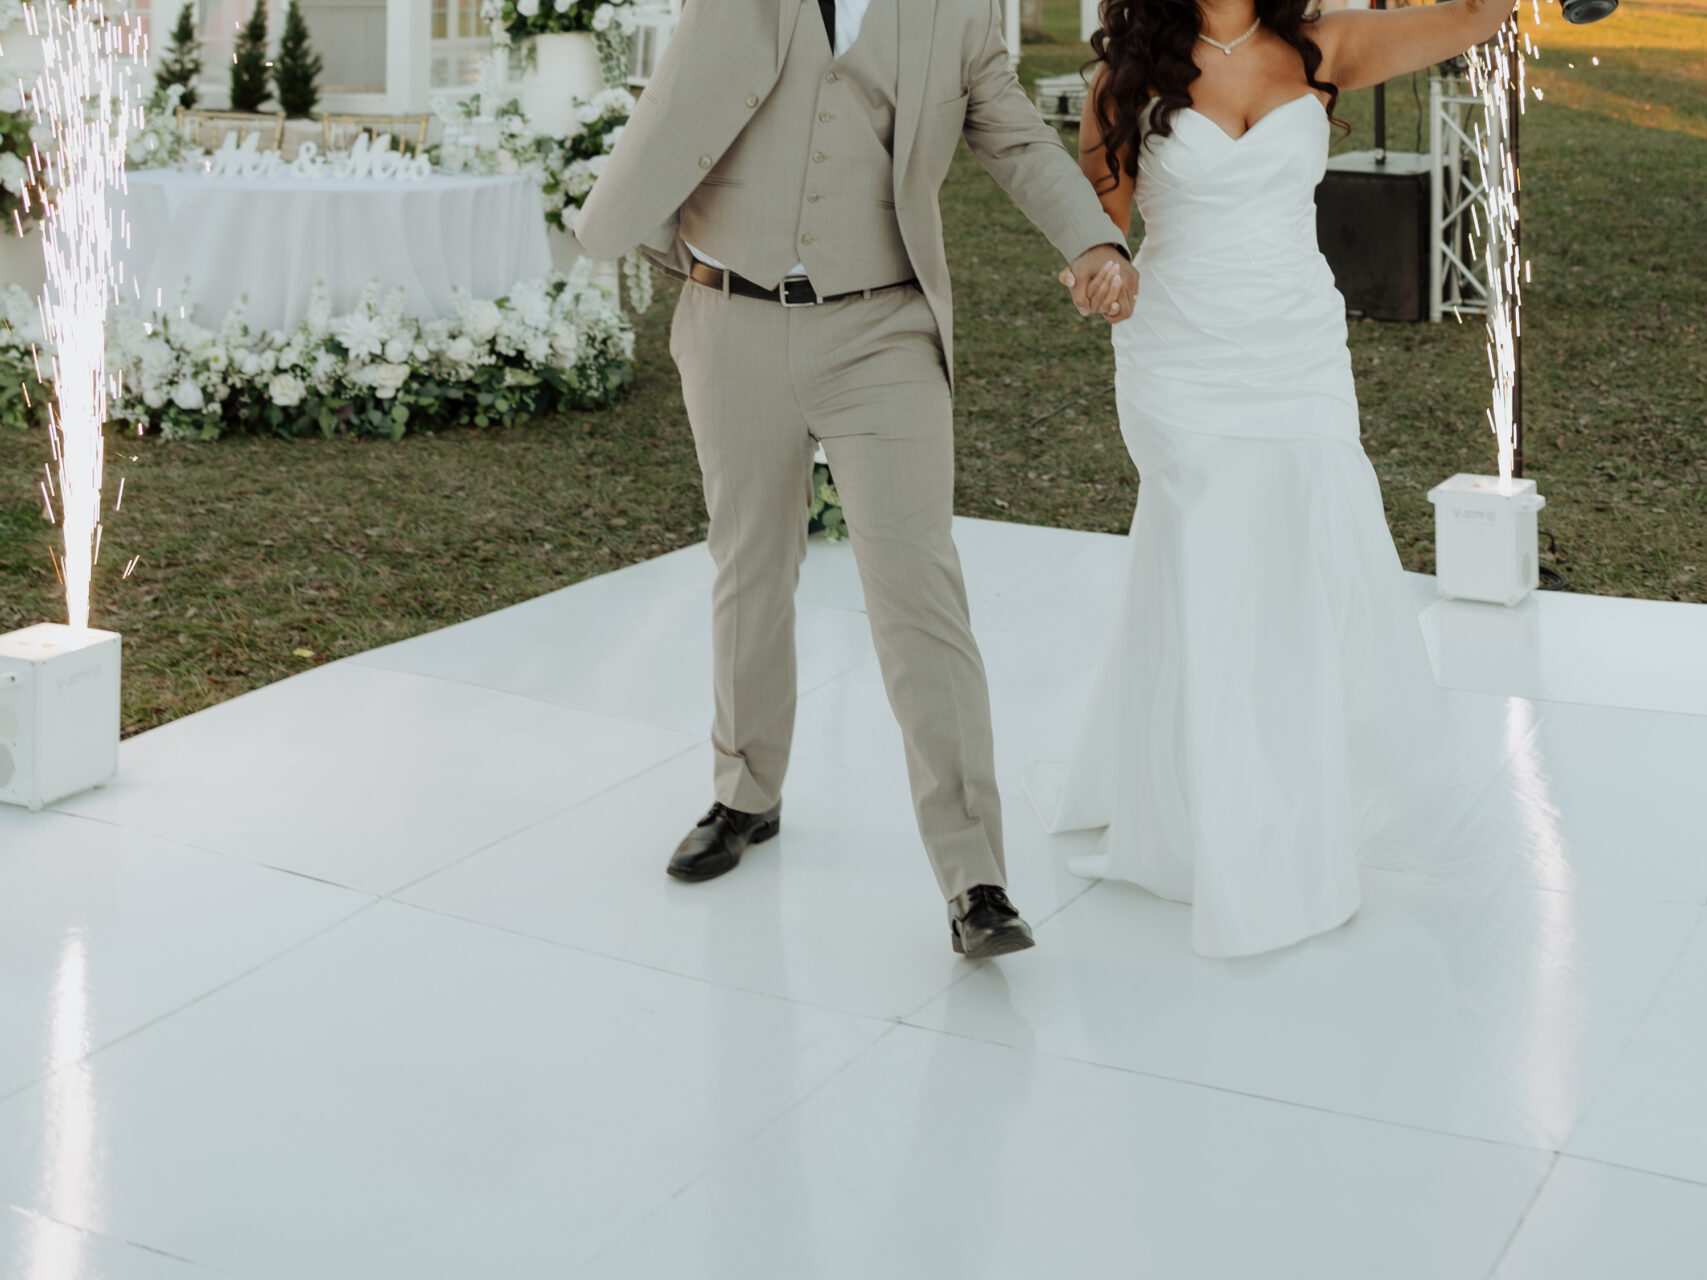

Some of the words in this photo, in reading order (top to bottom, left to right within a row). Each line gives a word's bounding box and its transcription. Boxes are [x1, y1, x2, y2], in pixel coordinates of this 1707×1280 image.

[203, 130, 281, 180] Mr
[292, 141, 326, 180] &
[332, 132, 431, 181] Mrs
